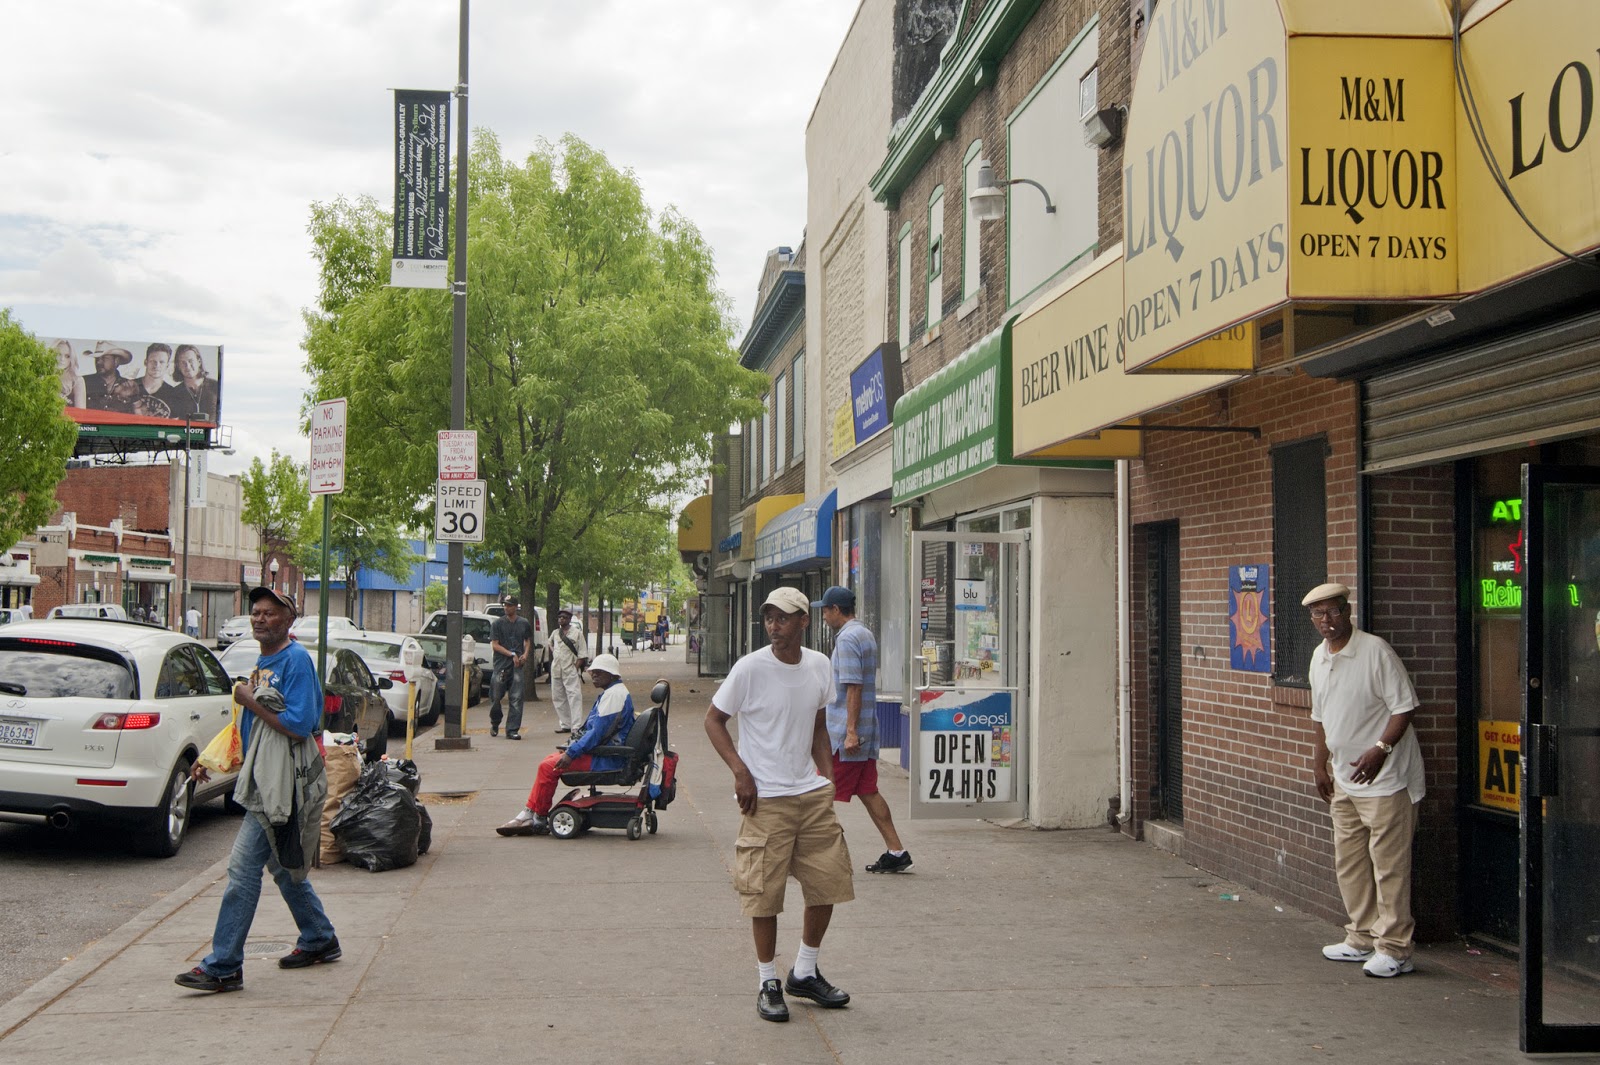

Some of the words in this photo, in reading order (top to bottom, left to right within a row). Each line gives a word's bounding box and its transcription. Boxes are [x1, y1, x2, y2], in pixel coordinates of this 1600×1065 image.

[1157, 0, 1228, 93] M&M
[1339, 76, 1405, 122] M&M
[1508, 48, 1600, 180] LO
[429, 150, 437, 178] Heights
[1125, 56, 1284, 263] LIQUOR
[1300, 147, 1446, 224] LIQUOR
[428, 199, 436, 227] Central
[397, 224, 405, 256] Historic
[407, 220, 415, 256] LANGSTON
[416, 217, 425, 256] Arlington
[1300, 233, 1361, 258] OPEN
[1368, 236, 1380, 258] 7
[1388, 235, 1447, 260] DAYS
[1126, 278, 1183, 343] OPEN
[1190, 269, 1203, 312] 7
[1210, 223, 1285, 303] DAYS
[1021, 350, 1061, 408] BEER
[1064, 323, 1109, 387] WINE
[855, 371, 884, 418] metroPCS
[323, 407, 334, 420] NO
[314, 425, 343, 440] PARKING
[441, 432, 449, 440] NO
[450, 432, 474, 440] PARKING
[312, 457, 342, 470] 8AM-6PM
[440, 485, 482, 497] SPEED
[444, 499, 477, 509] LIMIT
[442, 511, 478, 534] 30
[1492, 499, 1522, 521] AT
[963, 588, 978, 599] blu
[968, 712, 1009, 727] pepsi
[934, 733, 985, 764] OPEN
[1484, 730, 1499, 742] GET
[929, 768, 954, 800] 24
[961, 768, 997, 800] HRS
[1484, 747, 1520, 795] AT
